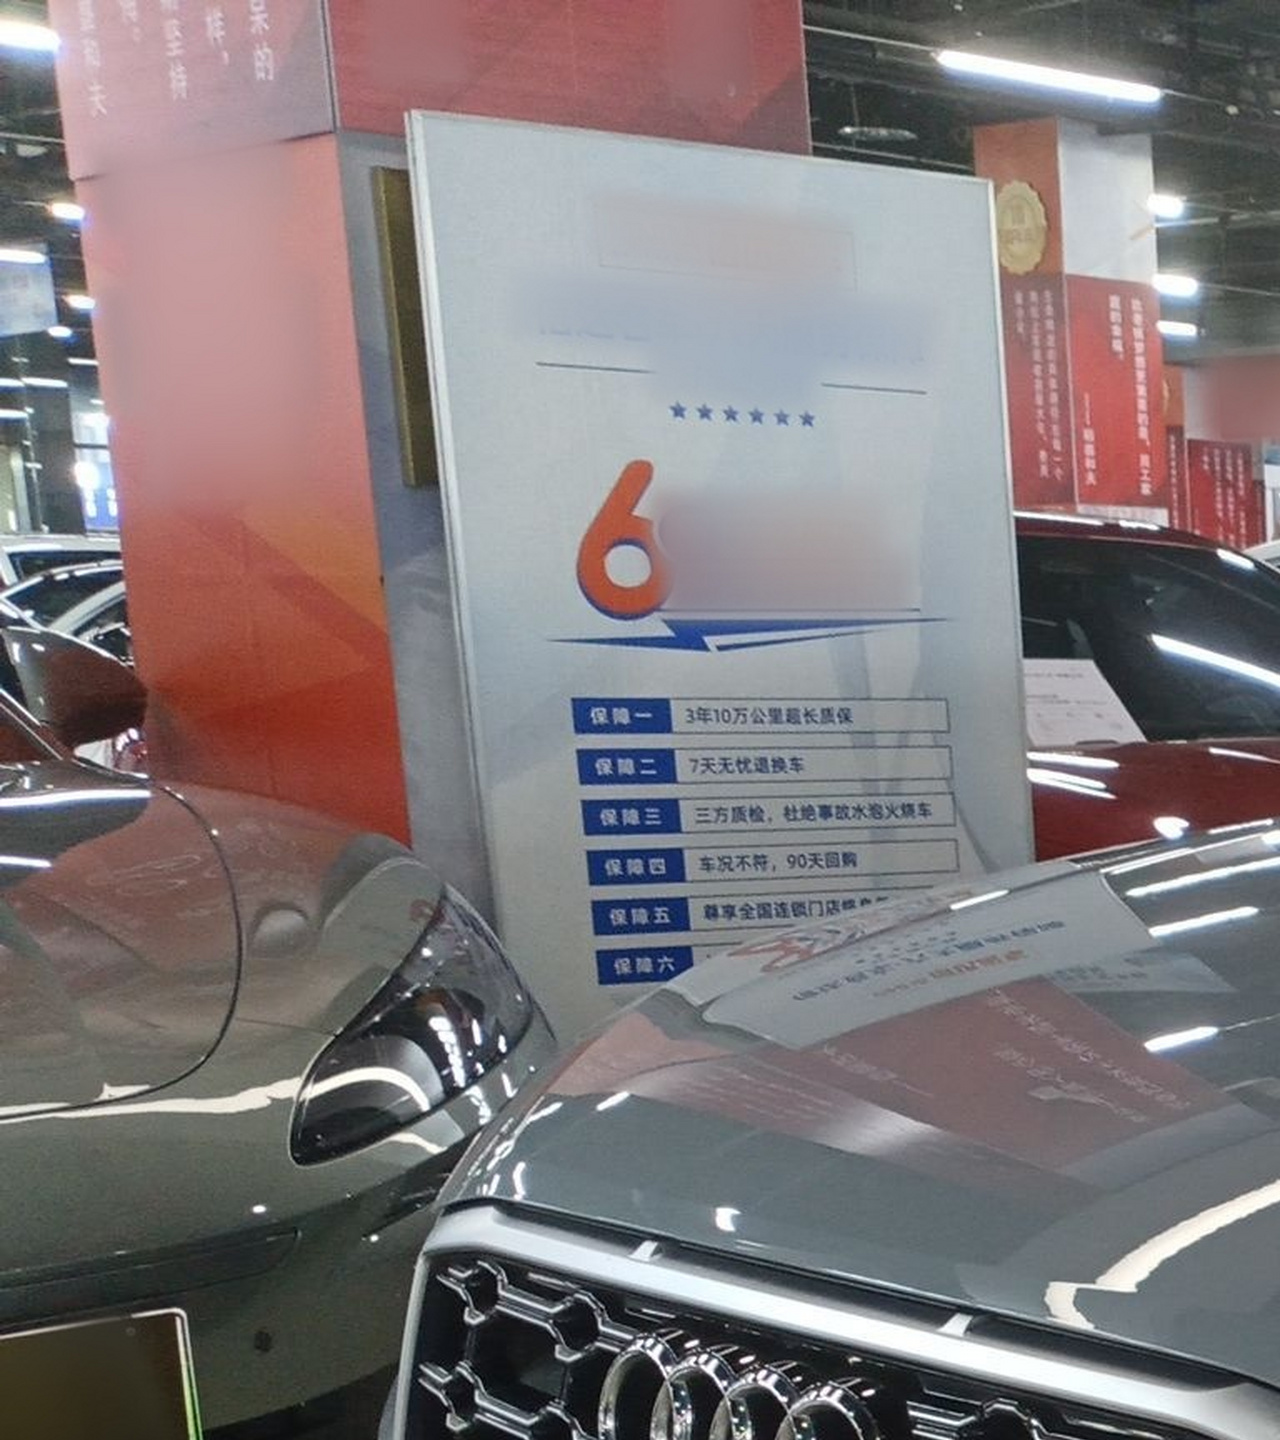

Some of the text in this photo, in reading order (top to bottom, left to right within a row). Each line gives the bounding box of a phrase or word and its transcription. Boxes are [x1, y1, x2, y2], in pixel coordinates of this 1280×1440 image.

[590, 706, 653, 726] 保障一
[685, 706, 854, 726] 3年10万公里超长质保
[595, 757, 657, 777] 保障二
[689, 756, 805, 776] 7天无忧退换车
[600, 807, 662, 827] 保障三
[605, 857, 667, 877] 保障四
[699, 851, 858, 873] 车况不符，90天回购
[610, 906, 671, 926] 保障五
[703, 896, 889, 921] 尊享全国连锁门店
[614, 955, 676, 976] 保障六
